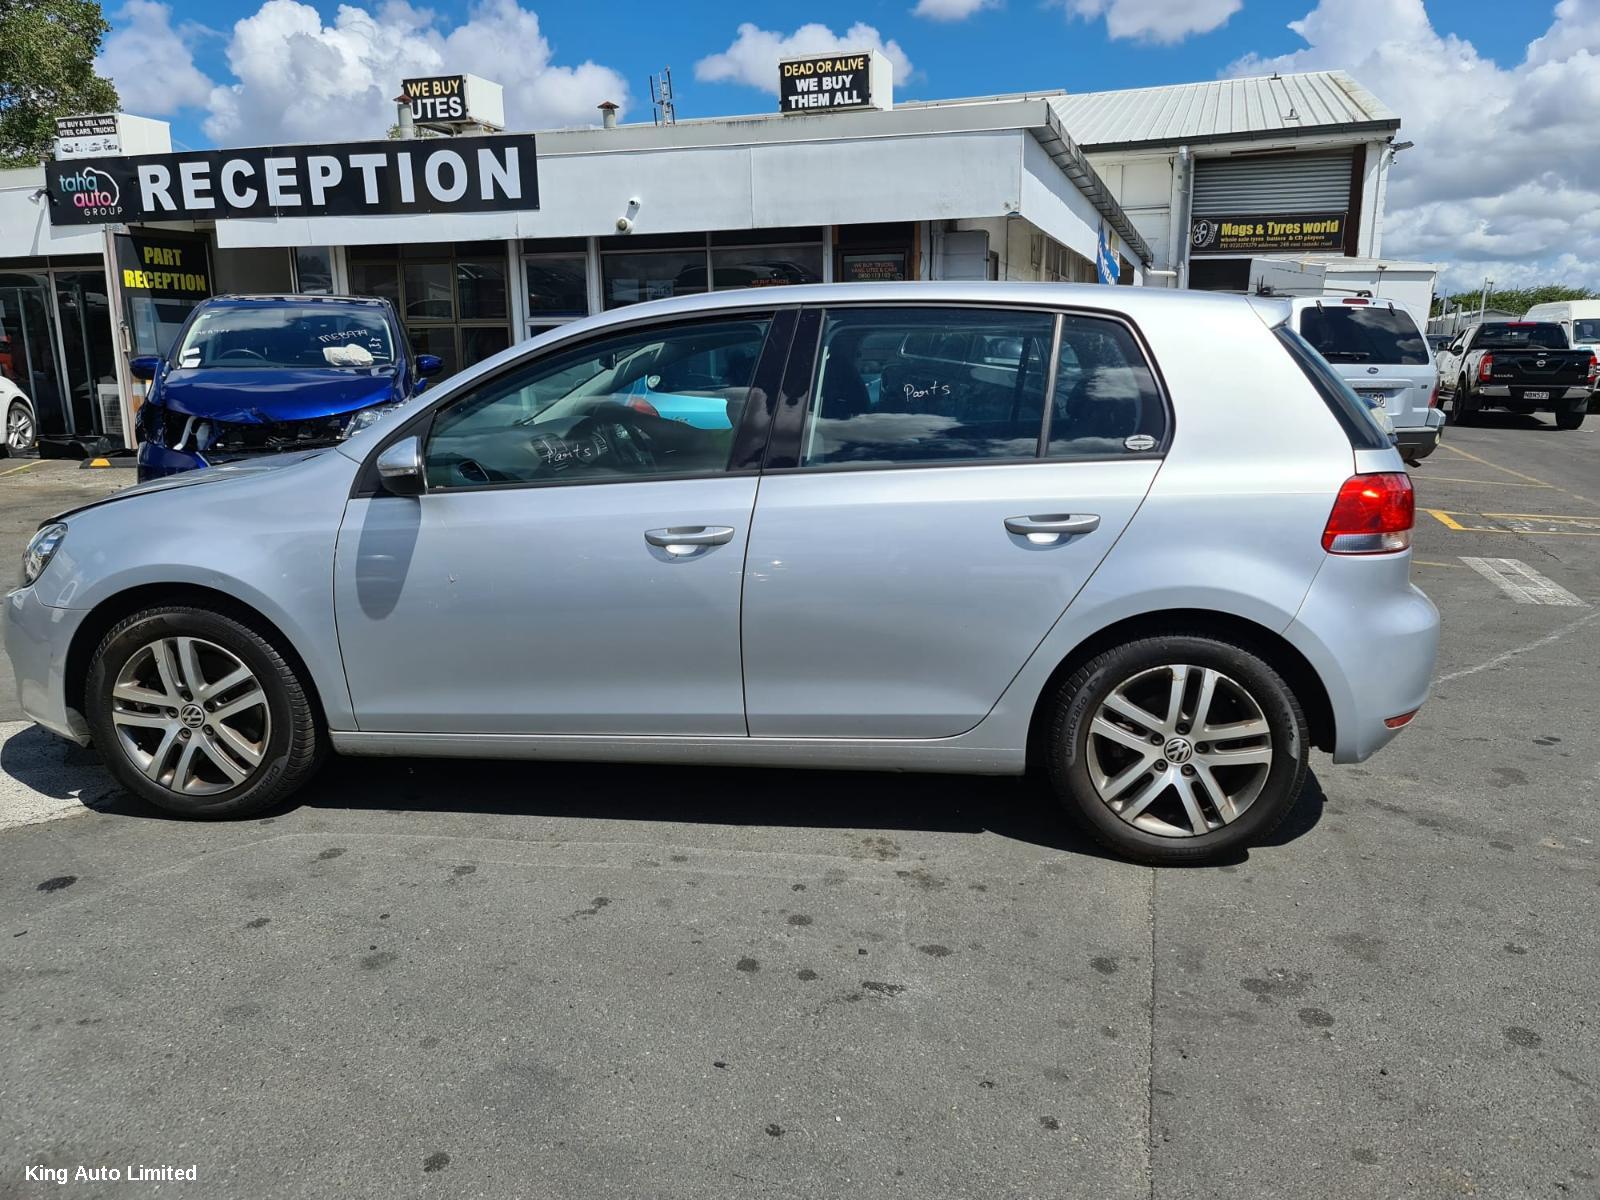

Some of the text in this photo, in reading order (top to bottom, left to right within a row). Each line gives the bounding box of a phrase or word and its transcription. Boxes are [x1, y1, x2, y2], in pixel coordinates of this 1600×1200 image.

[784, 58, 864, 77] DEAD OR ALIVE
[407, 80, 460, 97] WE BUY
[795, 75, 853, 92] WE BUY
[410, 96, 463, 120] UTES
[788, 90, 862, 109] THEM ALL
[58, 121, 66, 129] WE
[67, 120, 78, 128] BUY
[84, 119, 98, 127] SELL
[76, 128, 92, 136] CARS,
[93, 126, 115, 134] TRUCKS
[59, 171, 98, 192] taha
[137, 147, 522, 212] RECEPTION
[74, 191, 112, 207] auto
[84, 207, 123, 216] GROUP
[1221, 220, 1339, 236] Mags & Tyres world
[143, 246, 182, 266] PART
[123, 269, 206, 291] RECEPTION
